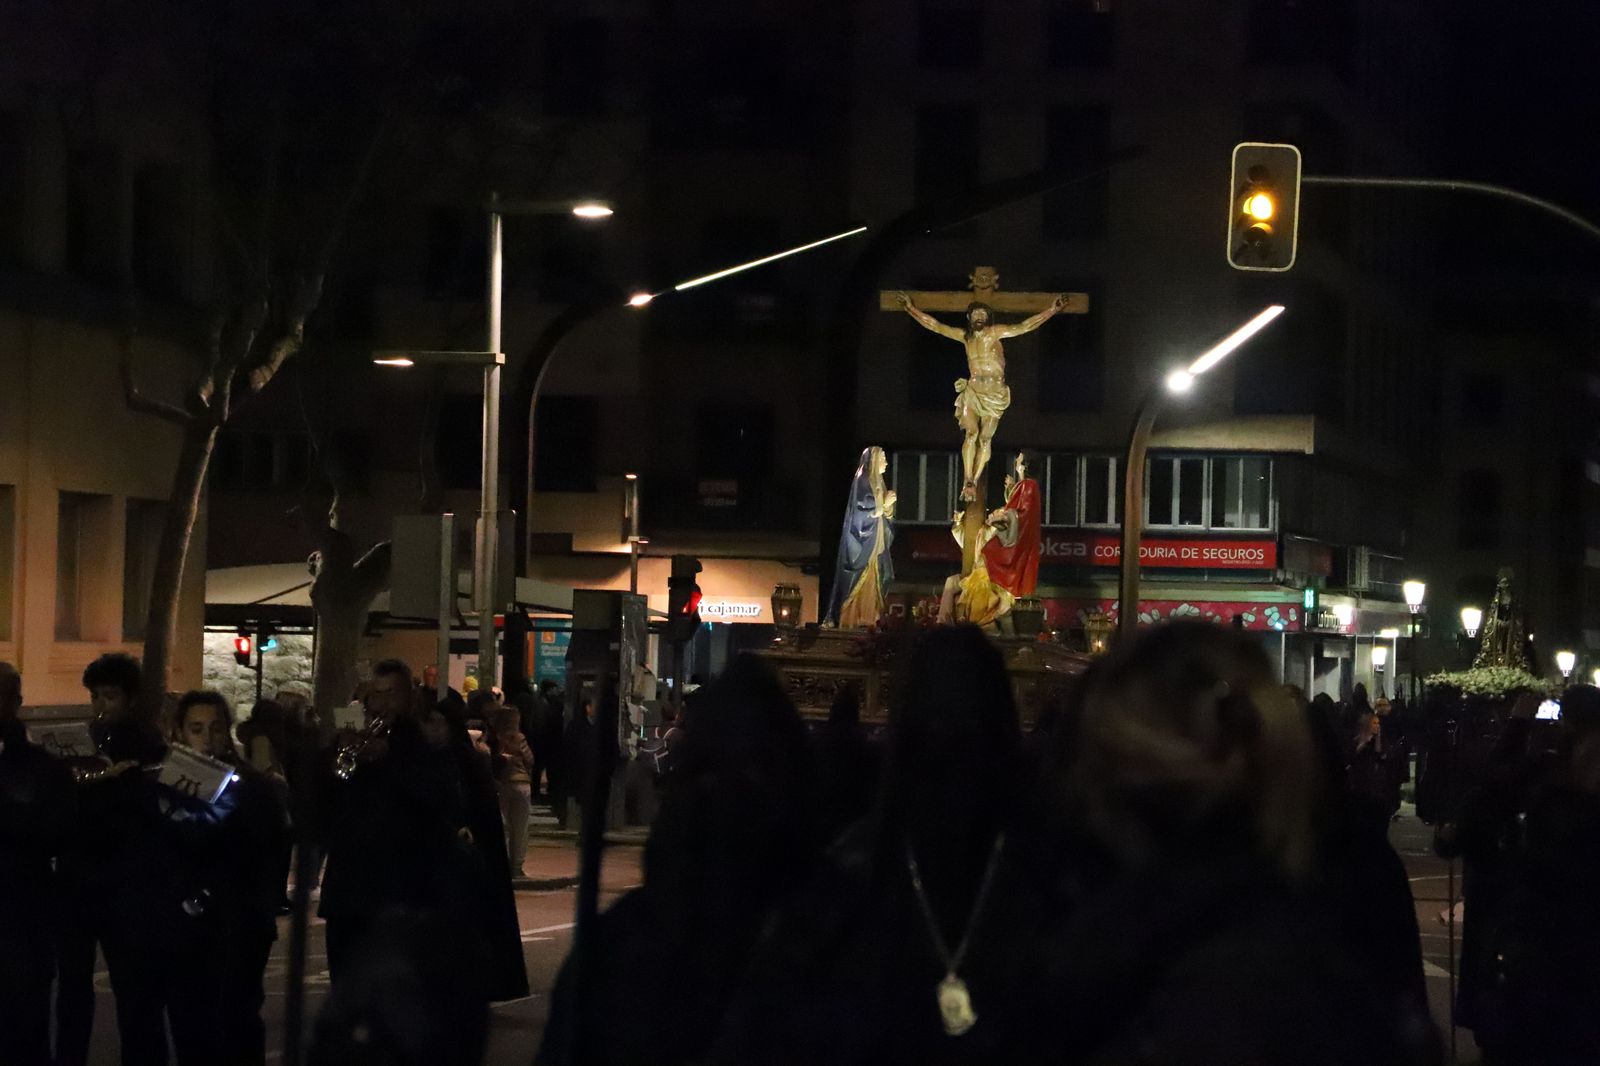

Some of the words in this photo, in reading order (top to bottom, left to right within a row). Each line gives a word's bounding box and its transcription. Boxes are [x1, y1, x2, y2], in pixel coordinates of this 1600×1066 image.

[1094, 546, 1178, 558] CORDURIA
[1181, 547, 1199, 559] DE
[1203, 548, 1264, 560] SEGUROS
[707, 602, 759, 616] cajamar
